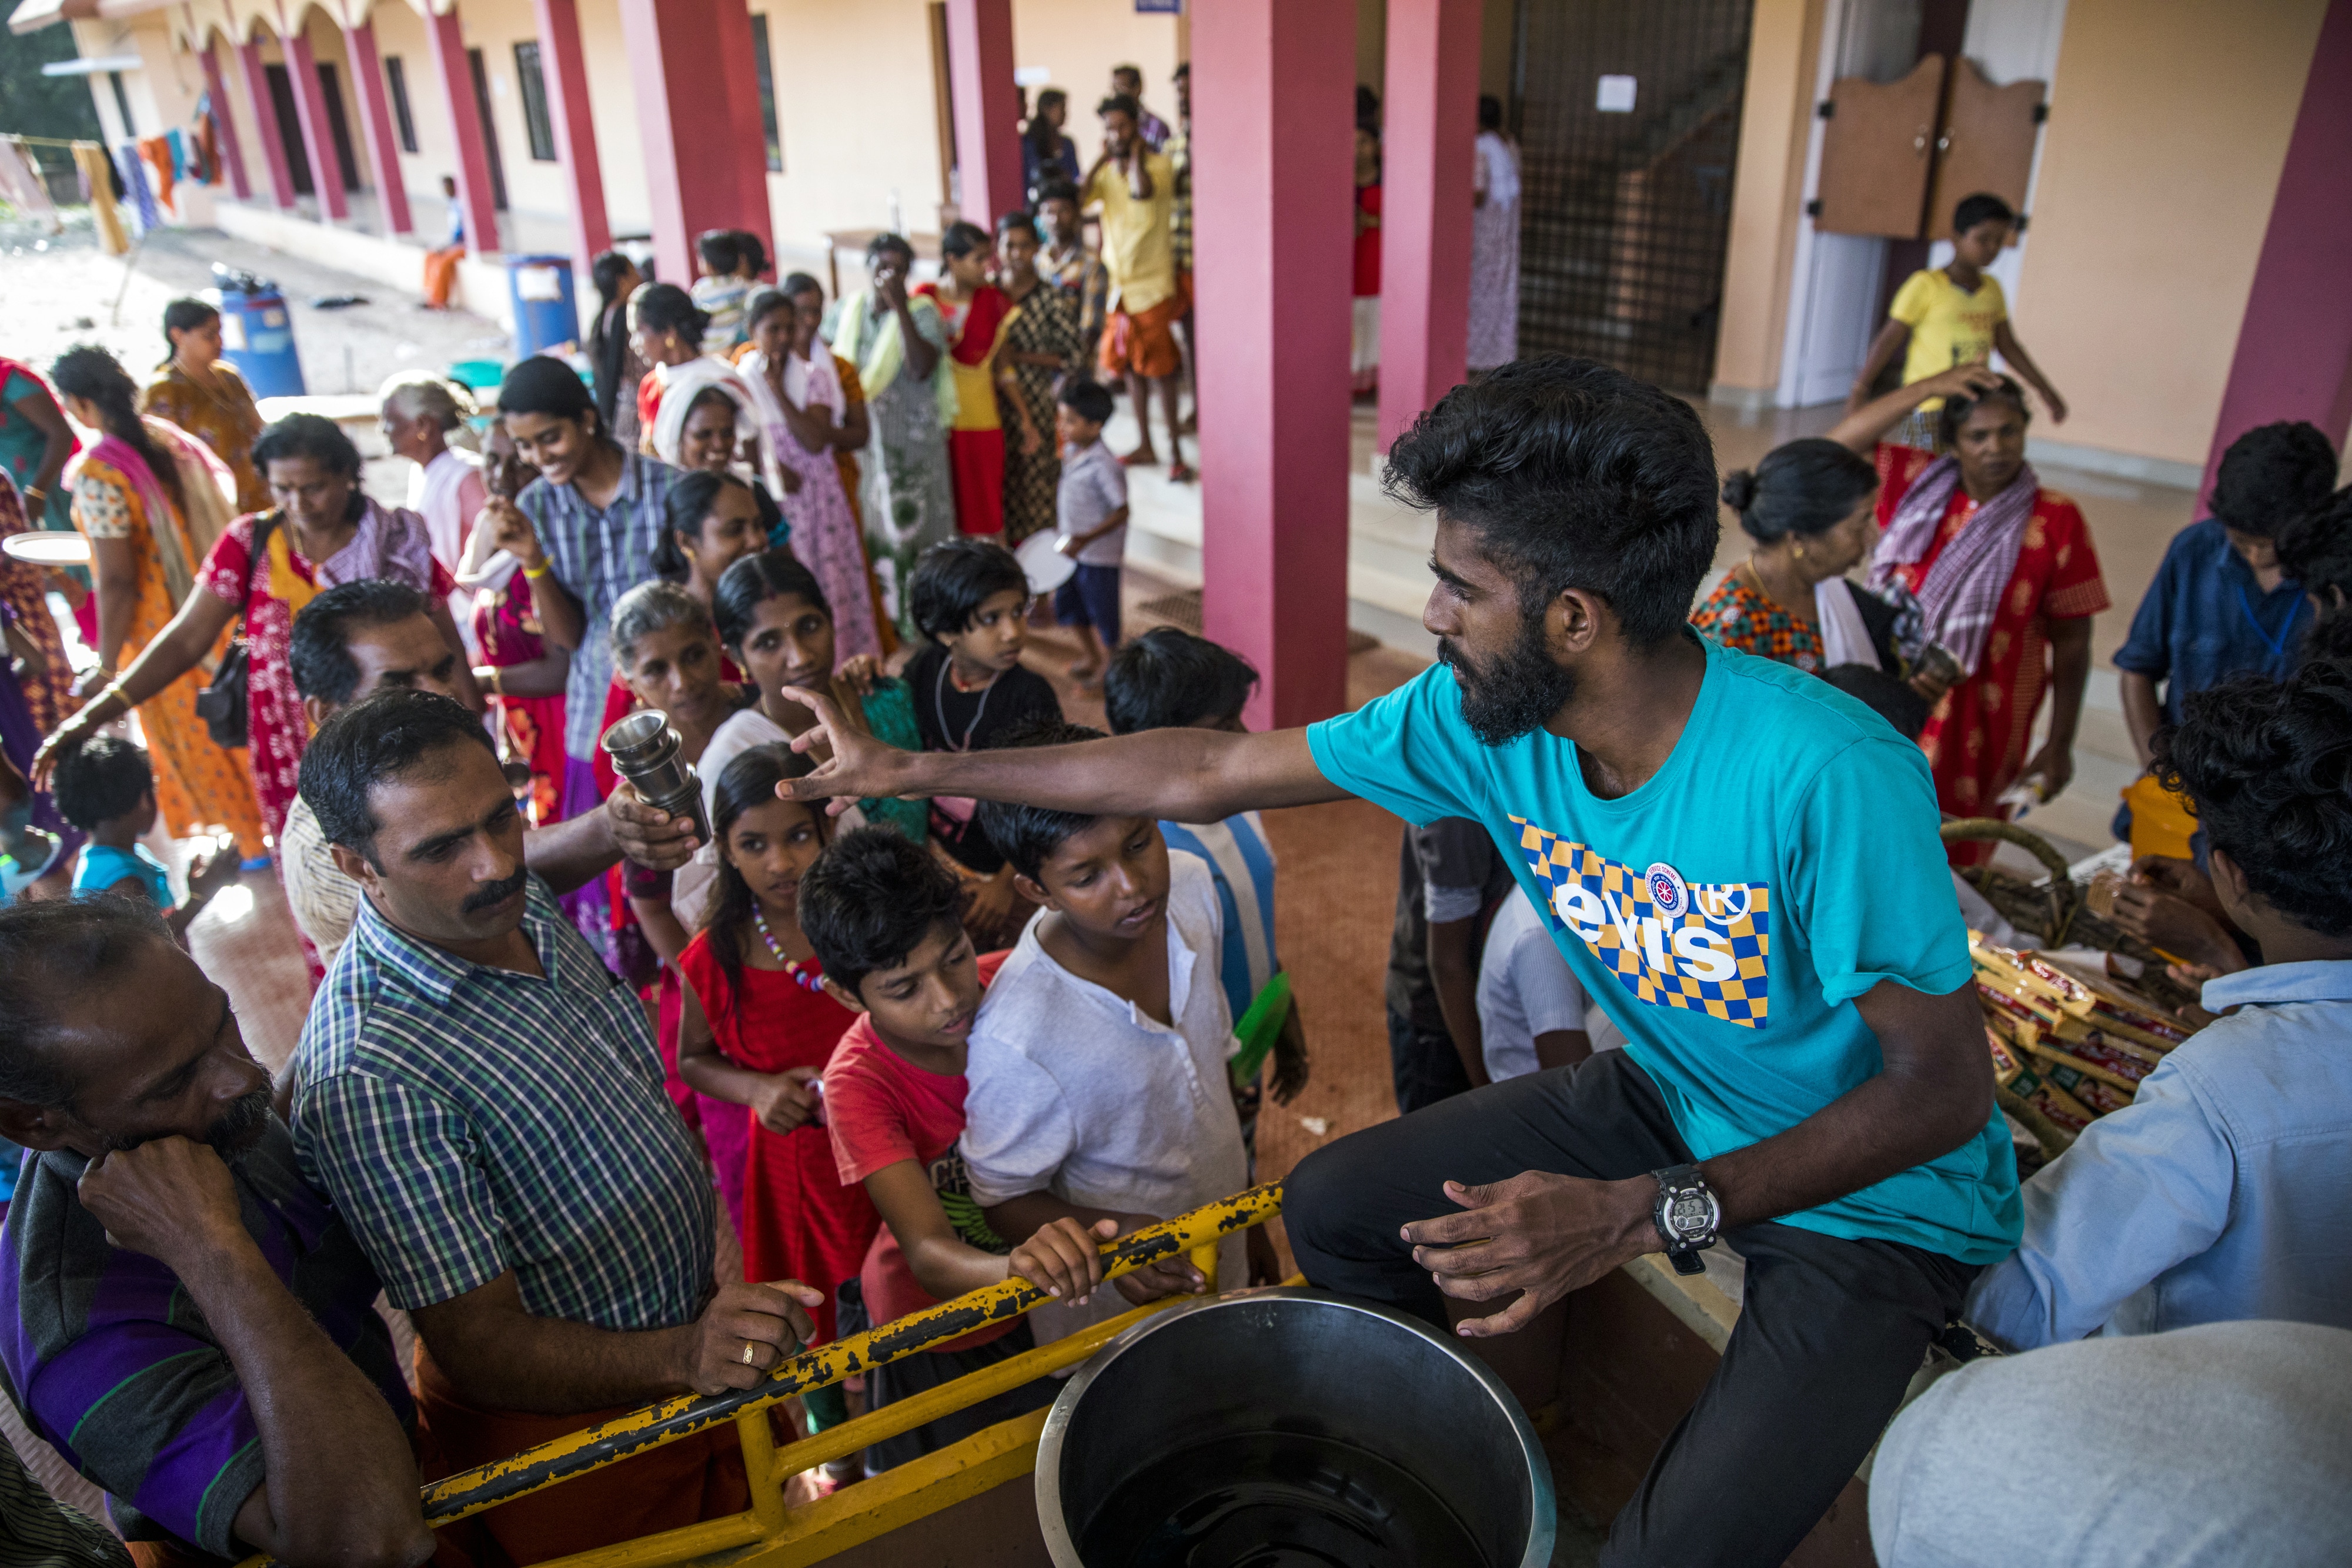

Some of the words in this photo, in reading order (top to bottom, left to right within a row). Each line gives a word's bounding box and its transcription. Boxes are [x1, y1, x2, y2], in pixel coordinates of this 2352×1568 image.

[1649, 865, 1661, 874] SERVICE
[1662, 866, 1677, 881] SCHEME
[1656, 896, 1669, 908] NATIONAL
[1668, 901, 1677, 909] SERVICE
